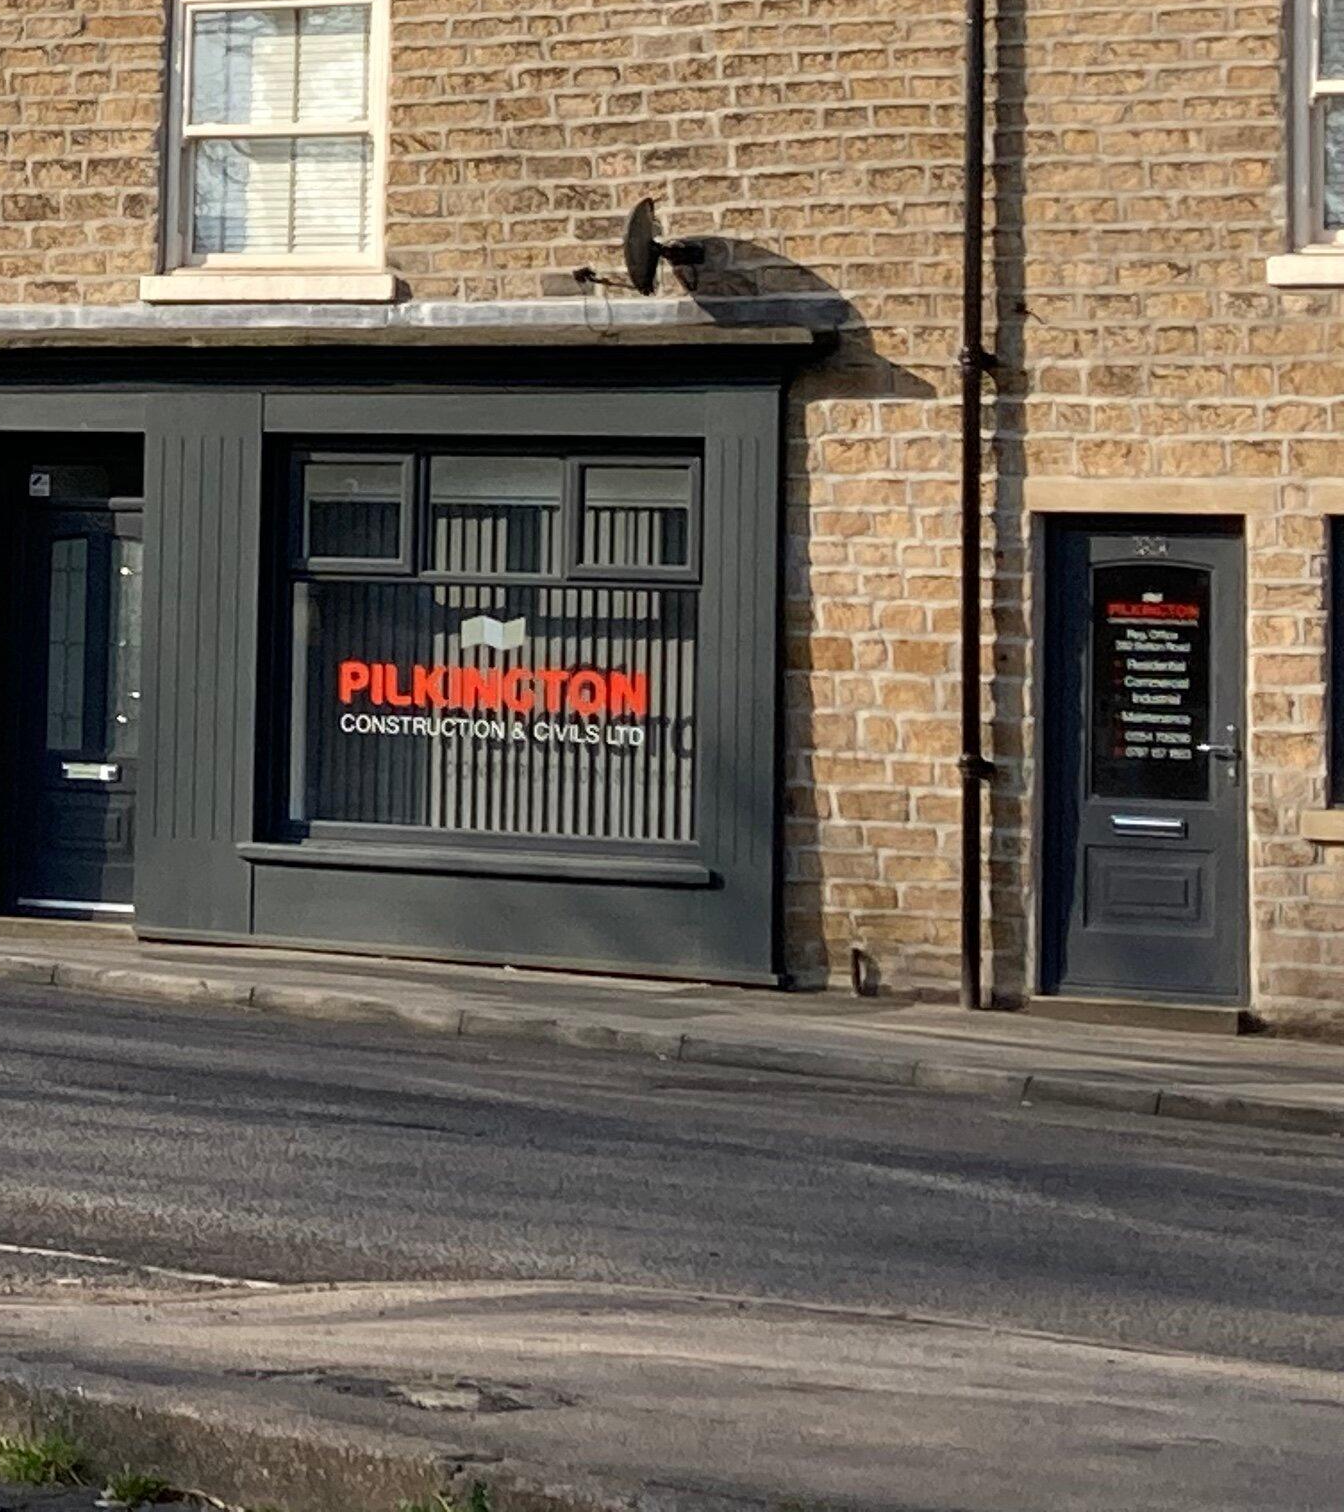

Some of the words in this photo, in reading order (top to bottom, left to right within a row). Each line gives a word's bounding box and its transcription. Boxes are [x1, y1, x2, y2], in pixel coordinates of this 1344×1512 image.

[338, 660, 649, 718] PILKINGTON
[340, 713, 506, 740] CONSTRUCTION
[512, 722, 527, 740] &
[533, 721, 601, 745] CIVILS
[606, 725, 646, 747] LTD
